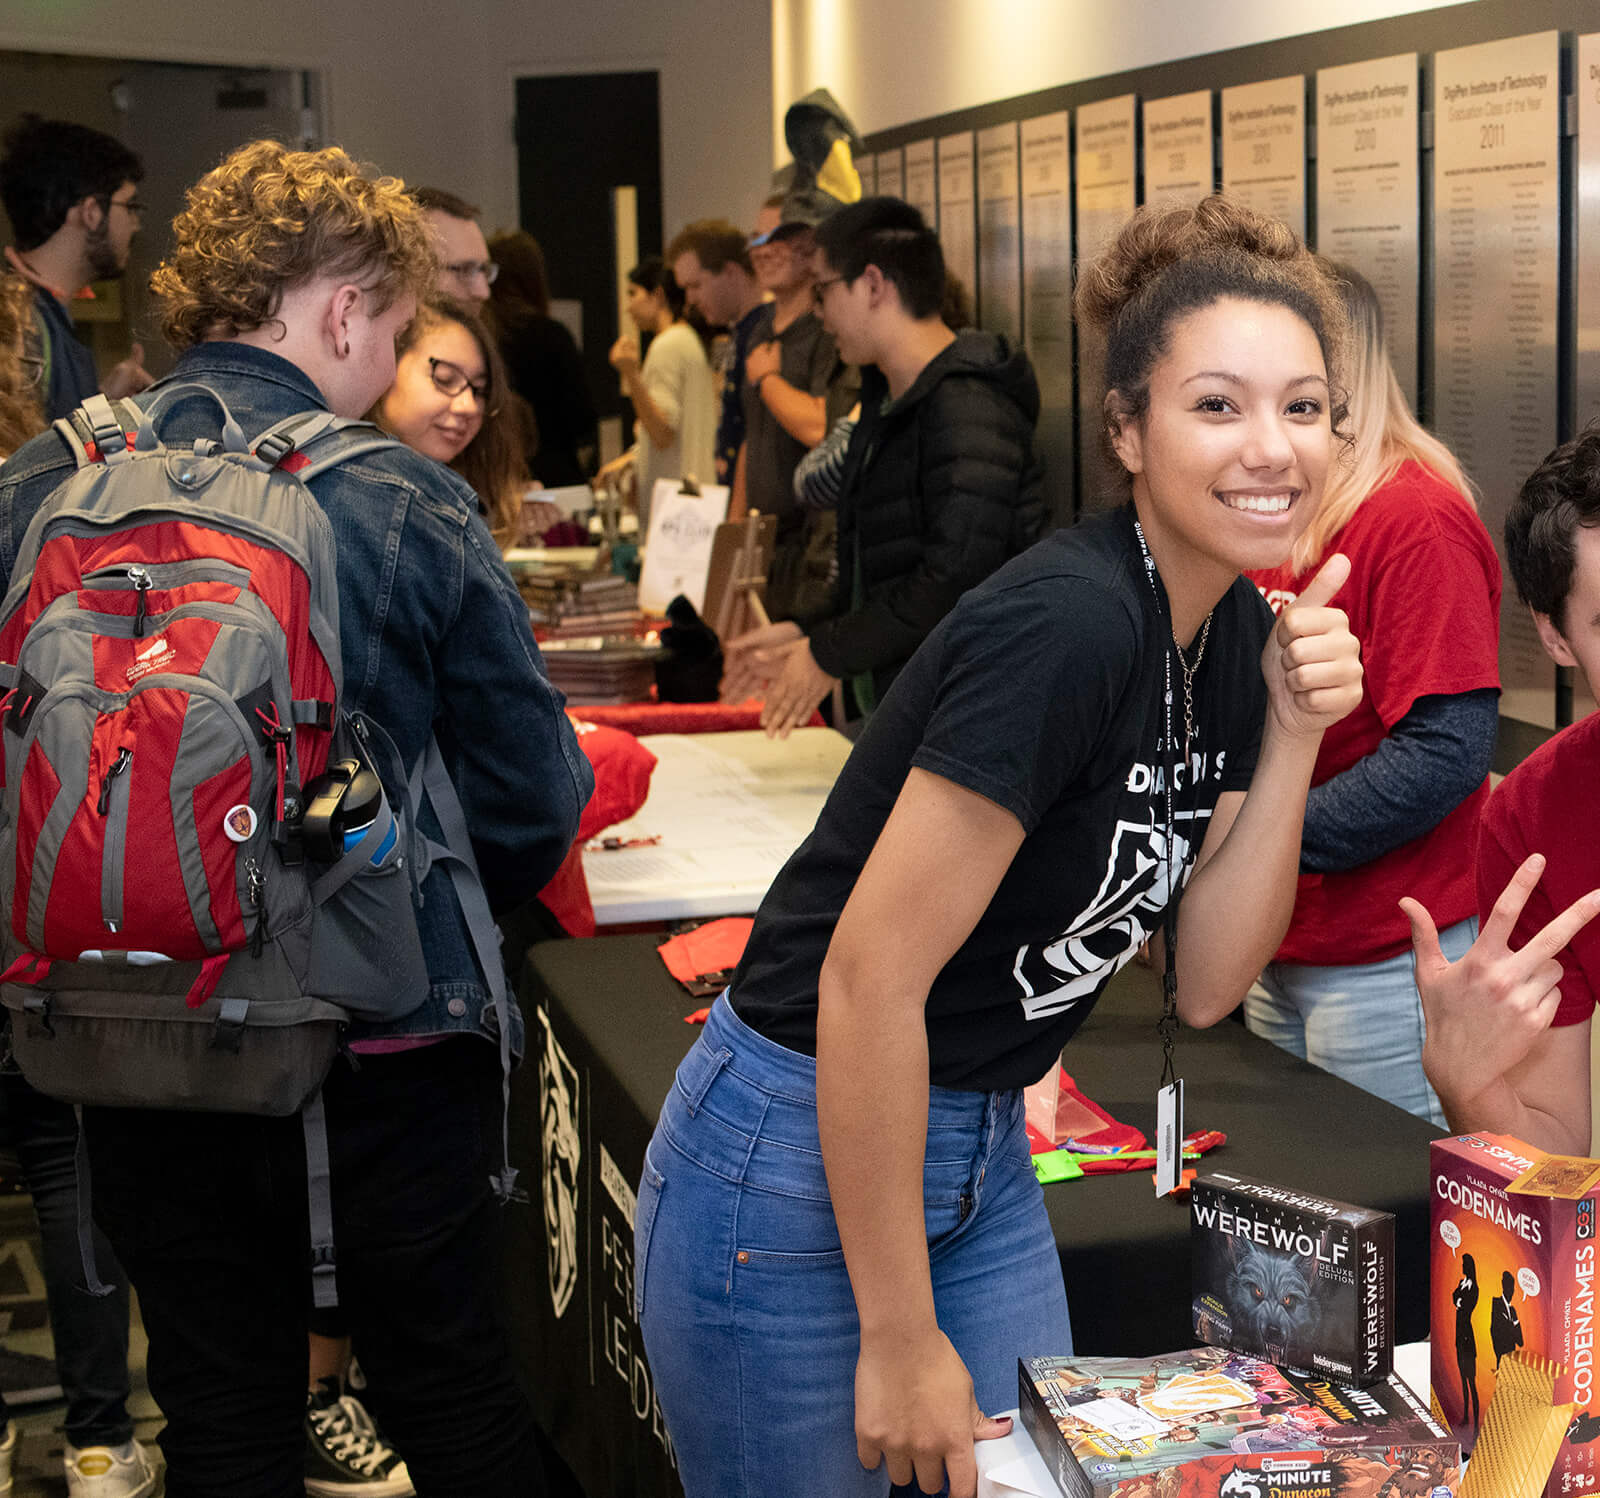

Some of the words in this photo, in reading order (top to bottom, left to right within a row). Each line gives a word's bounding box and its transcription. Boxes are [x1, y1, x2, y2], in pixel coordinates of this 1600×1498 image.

[1193, 1195, 1349, 1244] ULTIMATE
[1231, 1184, 1340, 1217] WEREWOLF
[1436, 1175, 1543, 1245] CODENAMES
[1193, 1204, 1349, 1265] WEREWOLF
[1319, 1263, 1354, 1277] DELUXE
[1319, 1270, 1355, 1285] EDITION
[1367, 1241, 1379, 1372] WEREWOLF
[1574, 1245, 1595, 1406] CODENAMES
